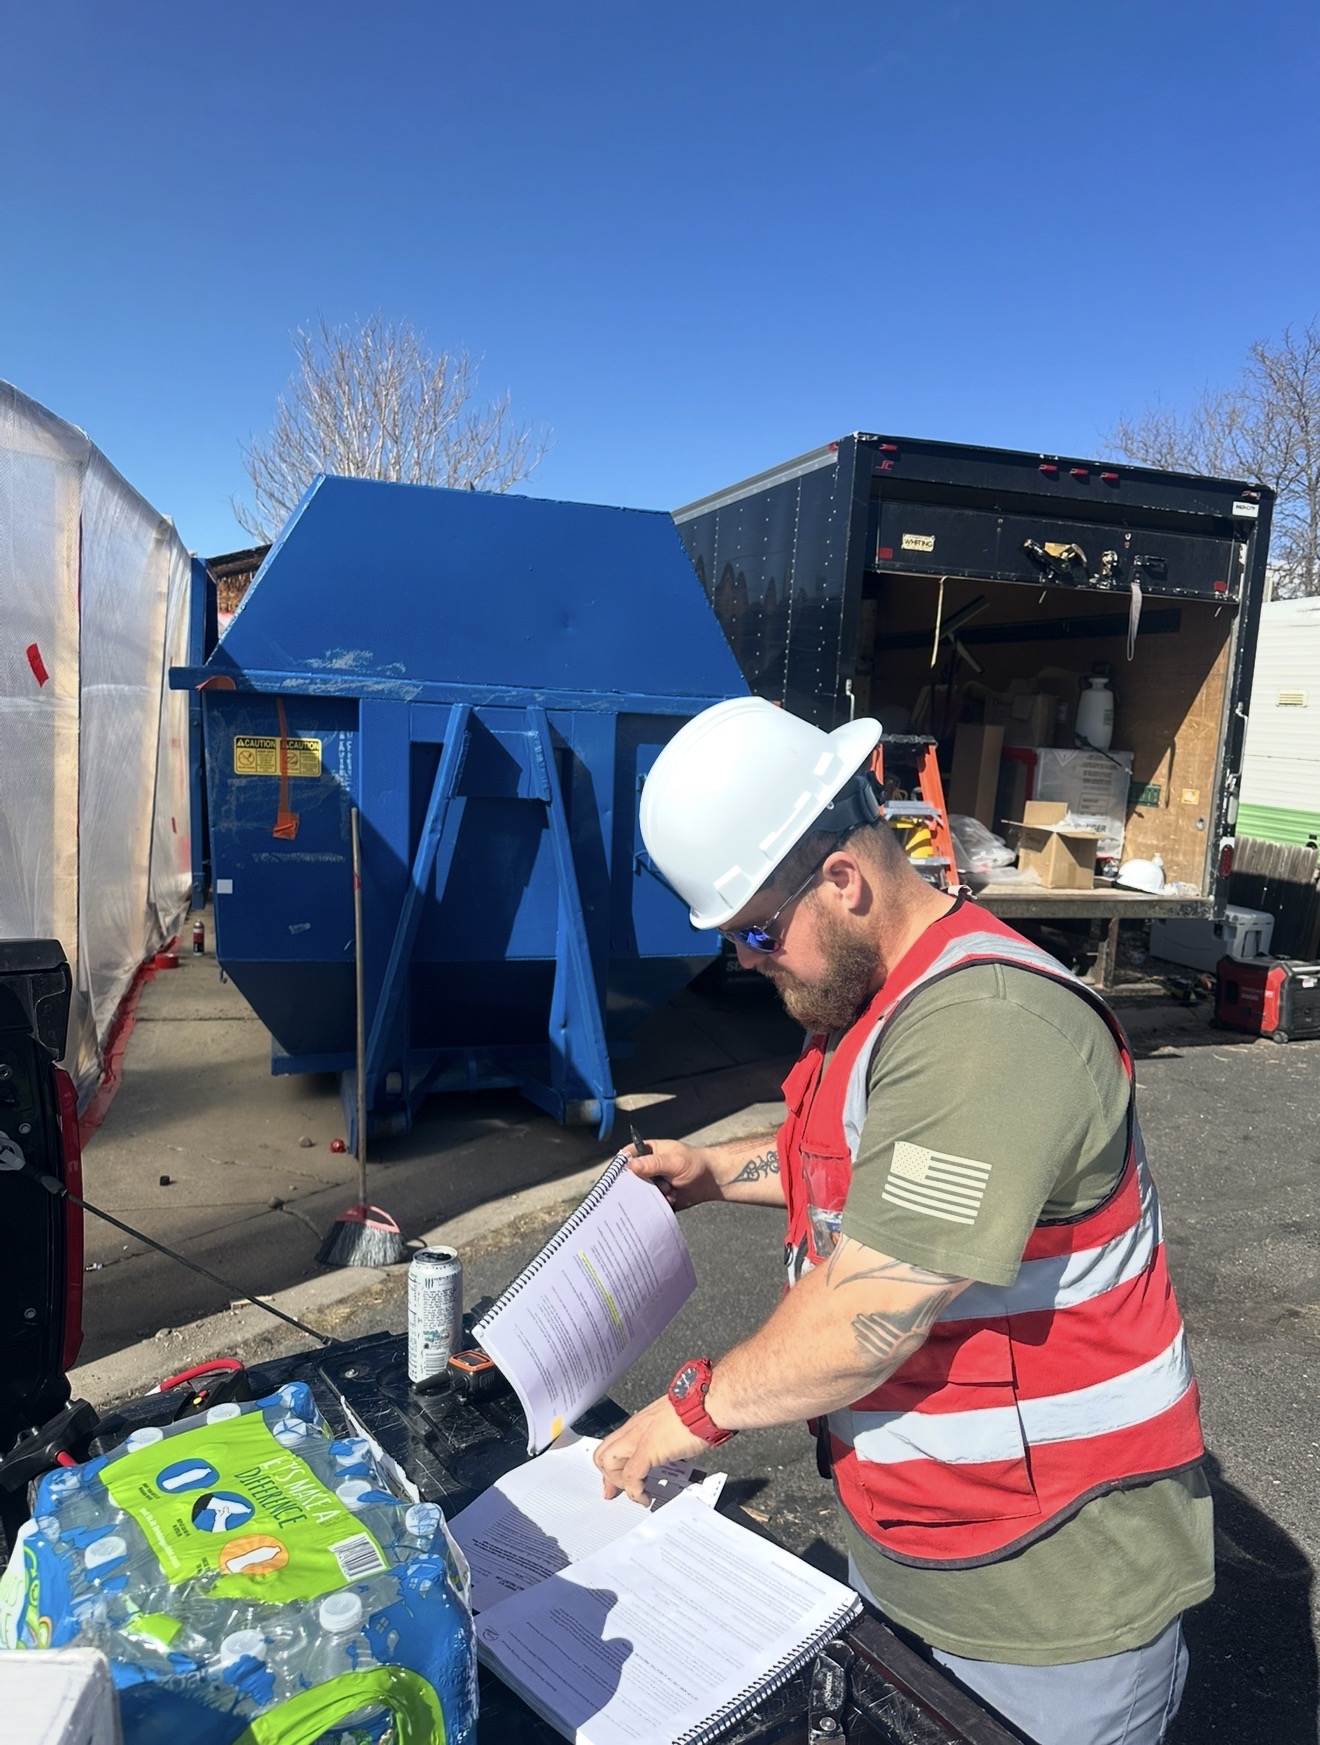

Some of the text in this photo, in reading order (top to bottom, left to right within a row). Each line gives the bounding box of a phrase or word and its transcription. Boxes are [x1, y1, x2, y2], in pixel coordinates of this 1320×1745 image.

[904, 538, 933, 548] WHITING
[244, 739, 276, 748] CAUTION
[288, 740, 320, 750] CAUTION
[234, 1466, 308, 1529] DIFFERENCE
[283, 1478, 332, 1511] MAKE
[311, 1509, 342, 1524] A
